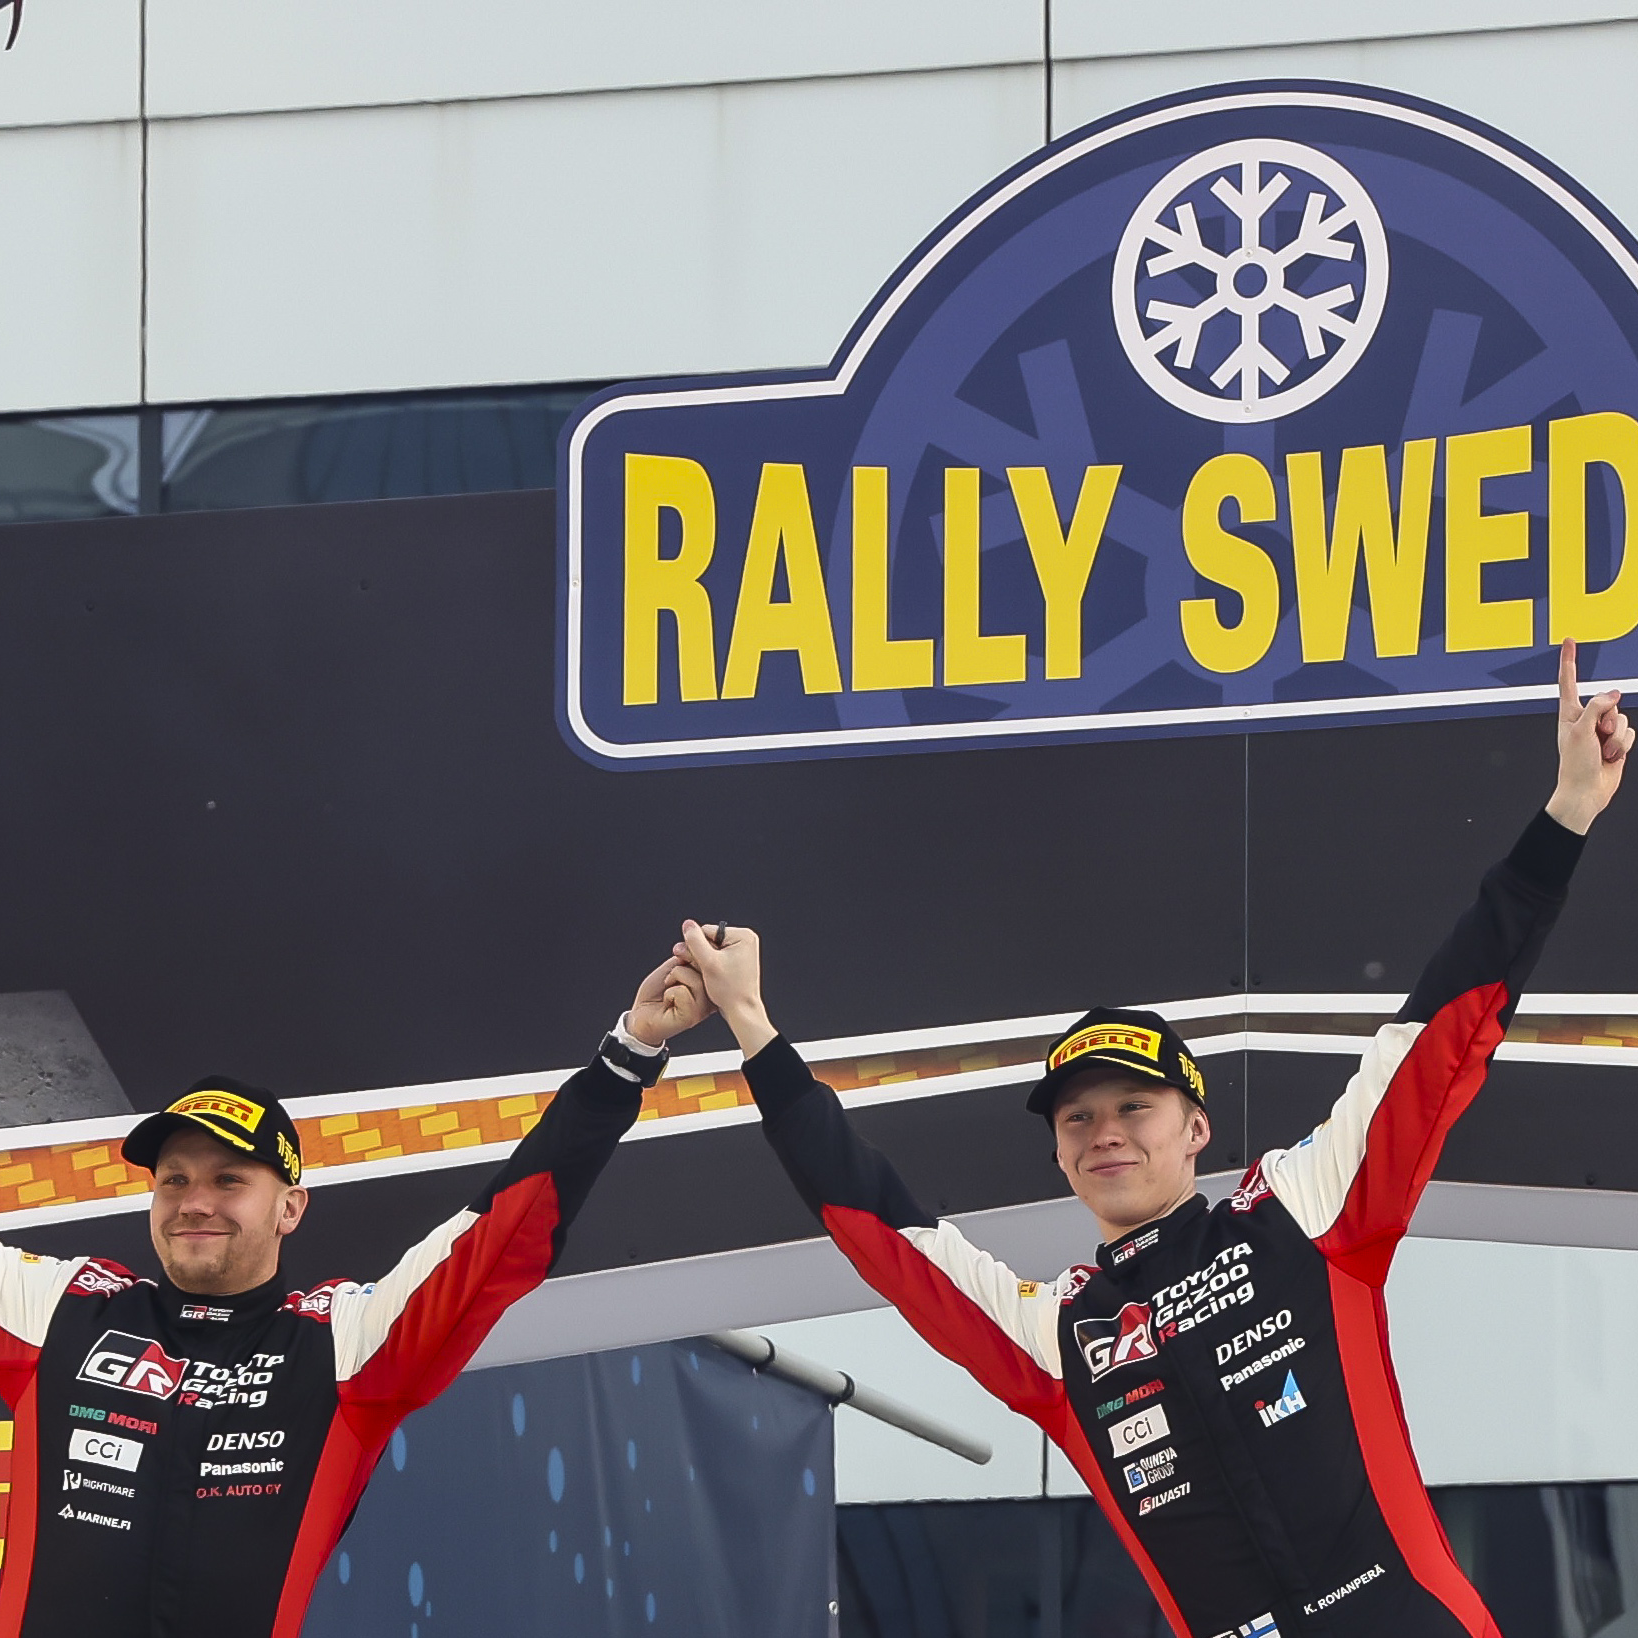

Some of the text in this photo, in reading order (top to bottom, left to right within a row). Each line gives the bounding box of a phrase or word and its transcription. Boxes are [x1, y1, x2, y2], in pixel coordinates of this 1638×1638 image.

[623, 452, 1123, 706] RALLY
[1151, 1242, 1254, 1308] TOYOTA
[1154, 1262, 1250, 1329] GAZOO
[1157, 1281, 1255, 1345] Racing
[1083, 1323, 1155, 1376] GR
[1215, 1309, 1293, 1366] DENSO
[84, 1351, 175, 1397] GR
[1219, 1337, 1306, 1392] Panasonic
[68, 1404, 158, 1435] DMG MORI
[1122, 1417, 1154, 1446] CCi
[84, 1438, 123, 1462] CCi
[206, 1430, 286, 1451] DENSO
[199, 1458, 285, 1477] Panasonic
[1147, 1462, 1175, 1484] GROUP
[82, 1478, 136, 1499] RIGHTWARE
[226, 1485, 263, 1497] AUTO
[1140, 1481, 1191, 1516] SILVASTI
[76, 1510, 132, 1531] MARINE.FI
[1303, 1563, 1386, 1615] K. ROVANPERÄ
